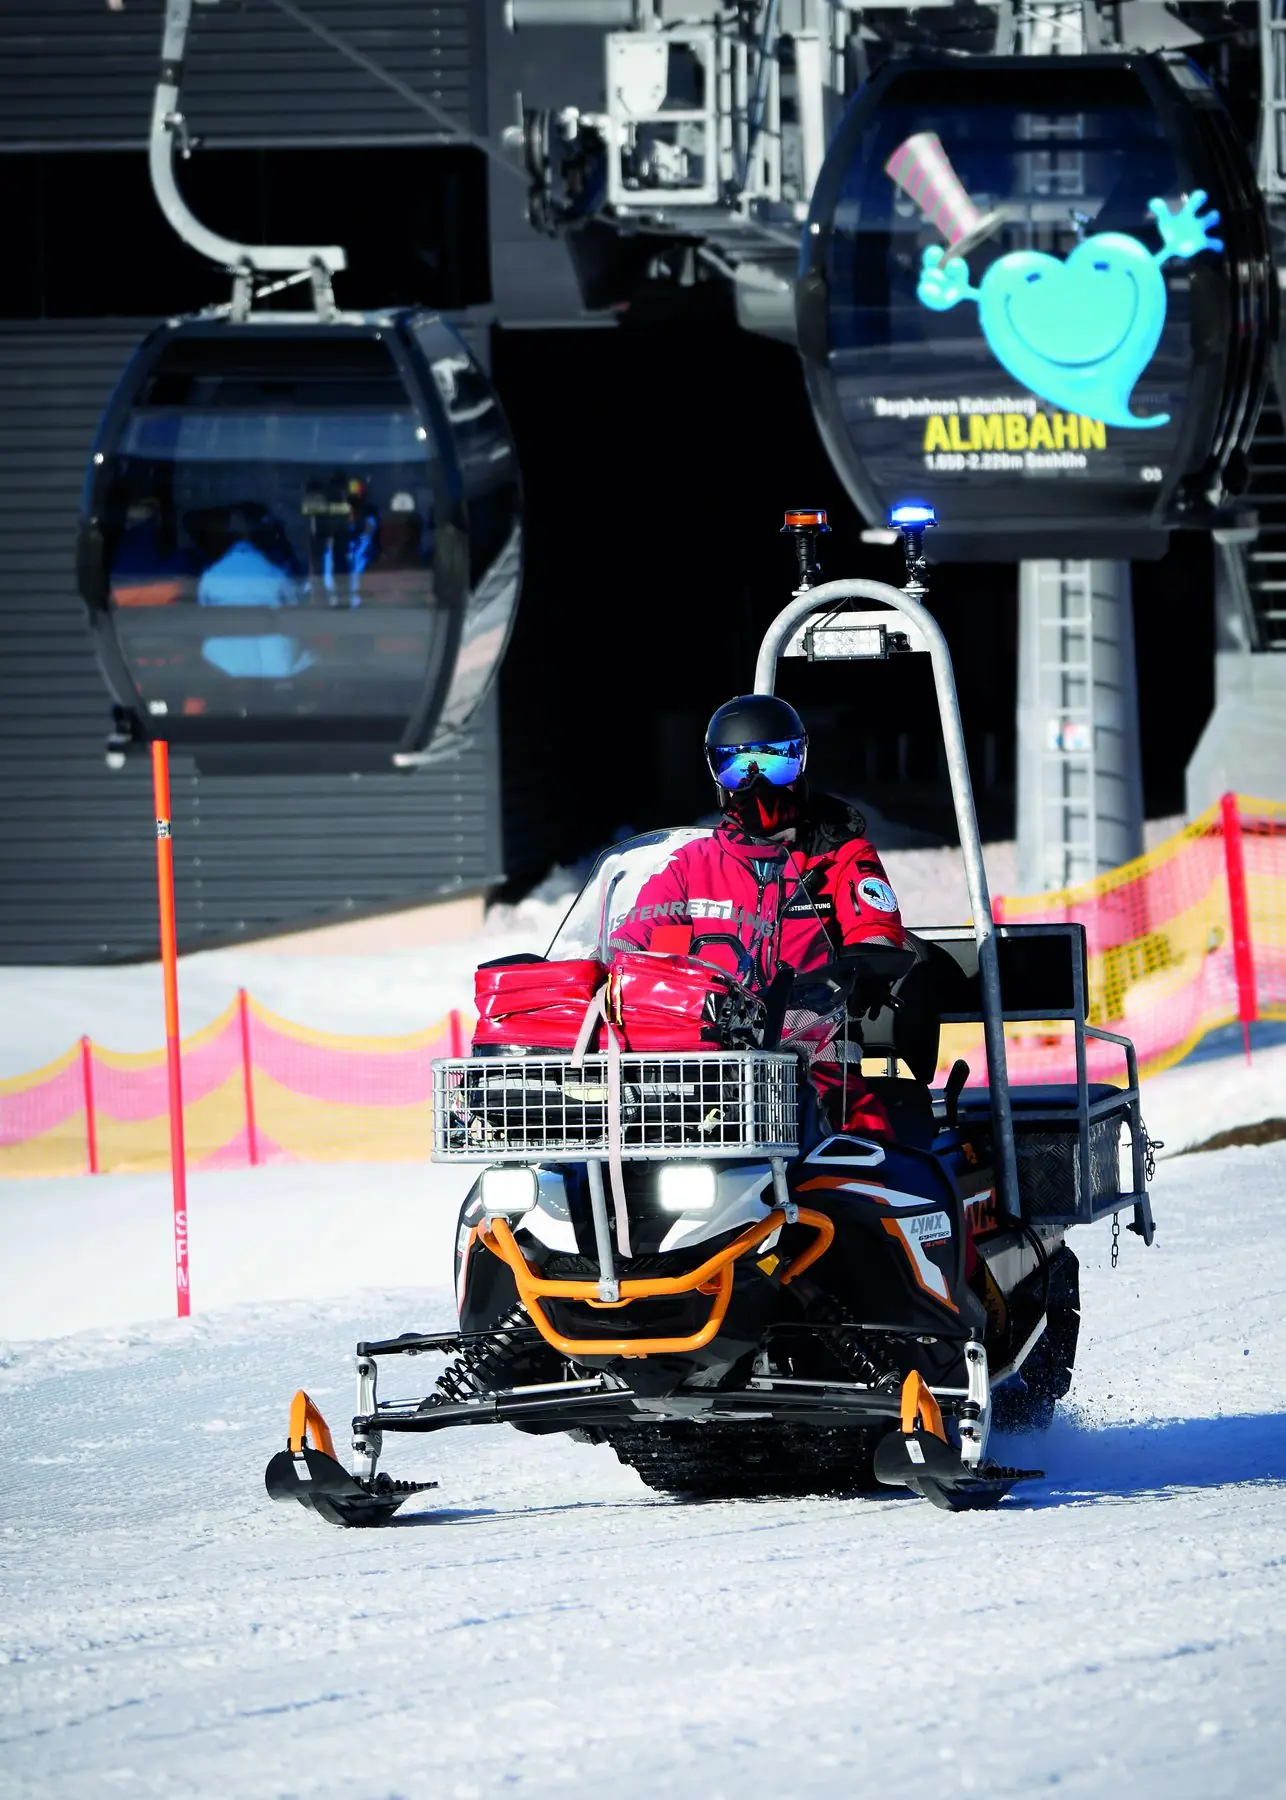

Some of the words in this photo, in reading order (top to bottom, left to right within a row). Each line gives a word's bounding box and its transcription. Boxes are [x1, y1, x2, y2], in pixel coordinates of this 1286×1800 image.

[924, 411, 1107, 451] ALMBAHN
[609, 901, 774, 937] ISTENRETTUNG
[910, 1214, 943, 1235] LYNX
